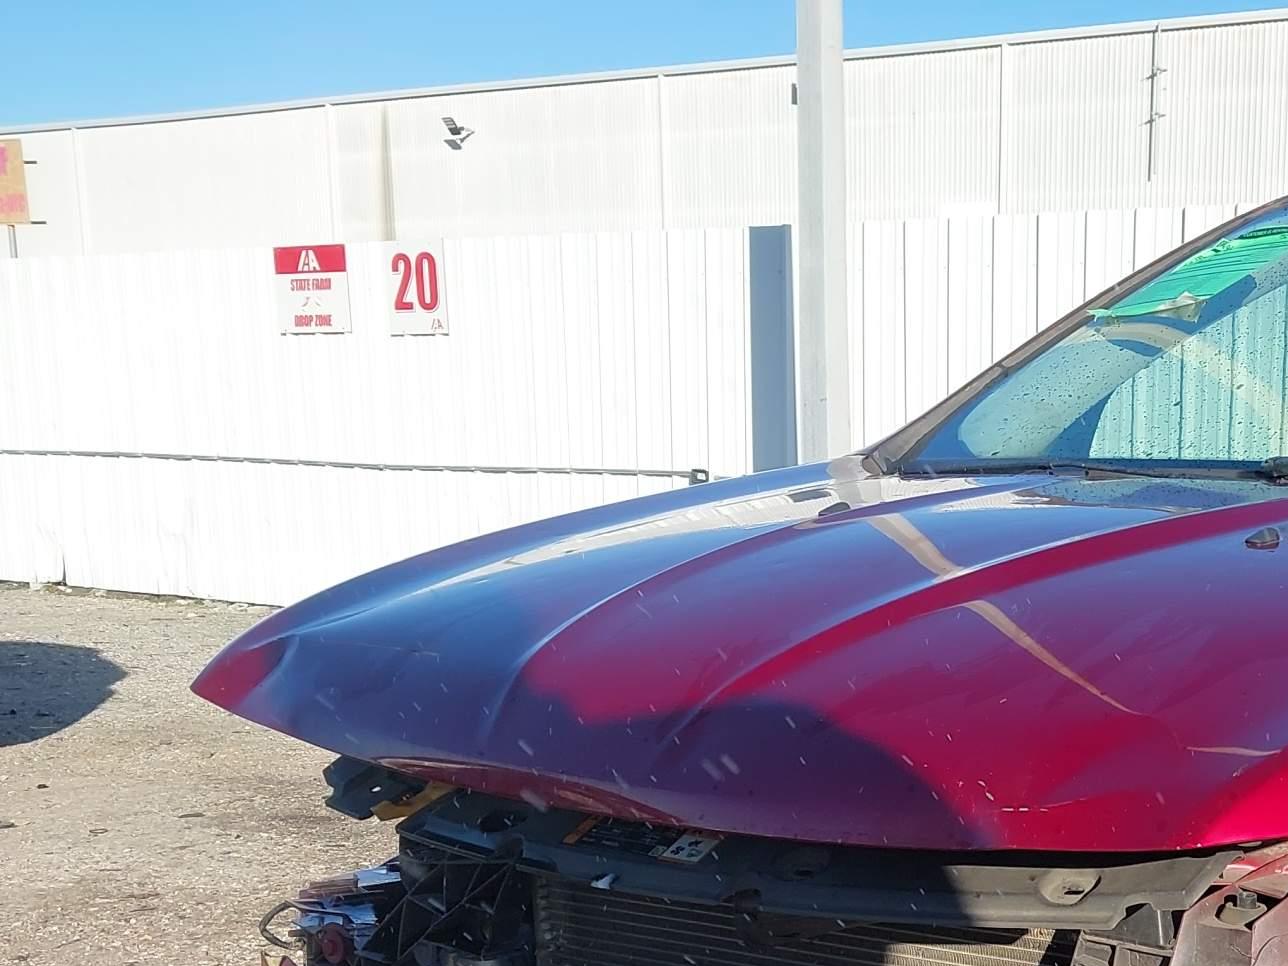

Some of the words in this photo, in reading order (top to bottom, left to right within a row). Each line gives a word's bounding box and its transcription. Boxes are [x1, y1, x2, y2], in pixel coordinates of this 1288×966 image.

[290, 278, 311, 292] STATE
[391, 251, 439, 311] 20
[294, 314, 314, 327] DROP
[315, 314, 332, 327] ZONE
